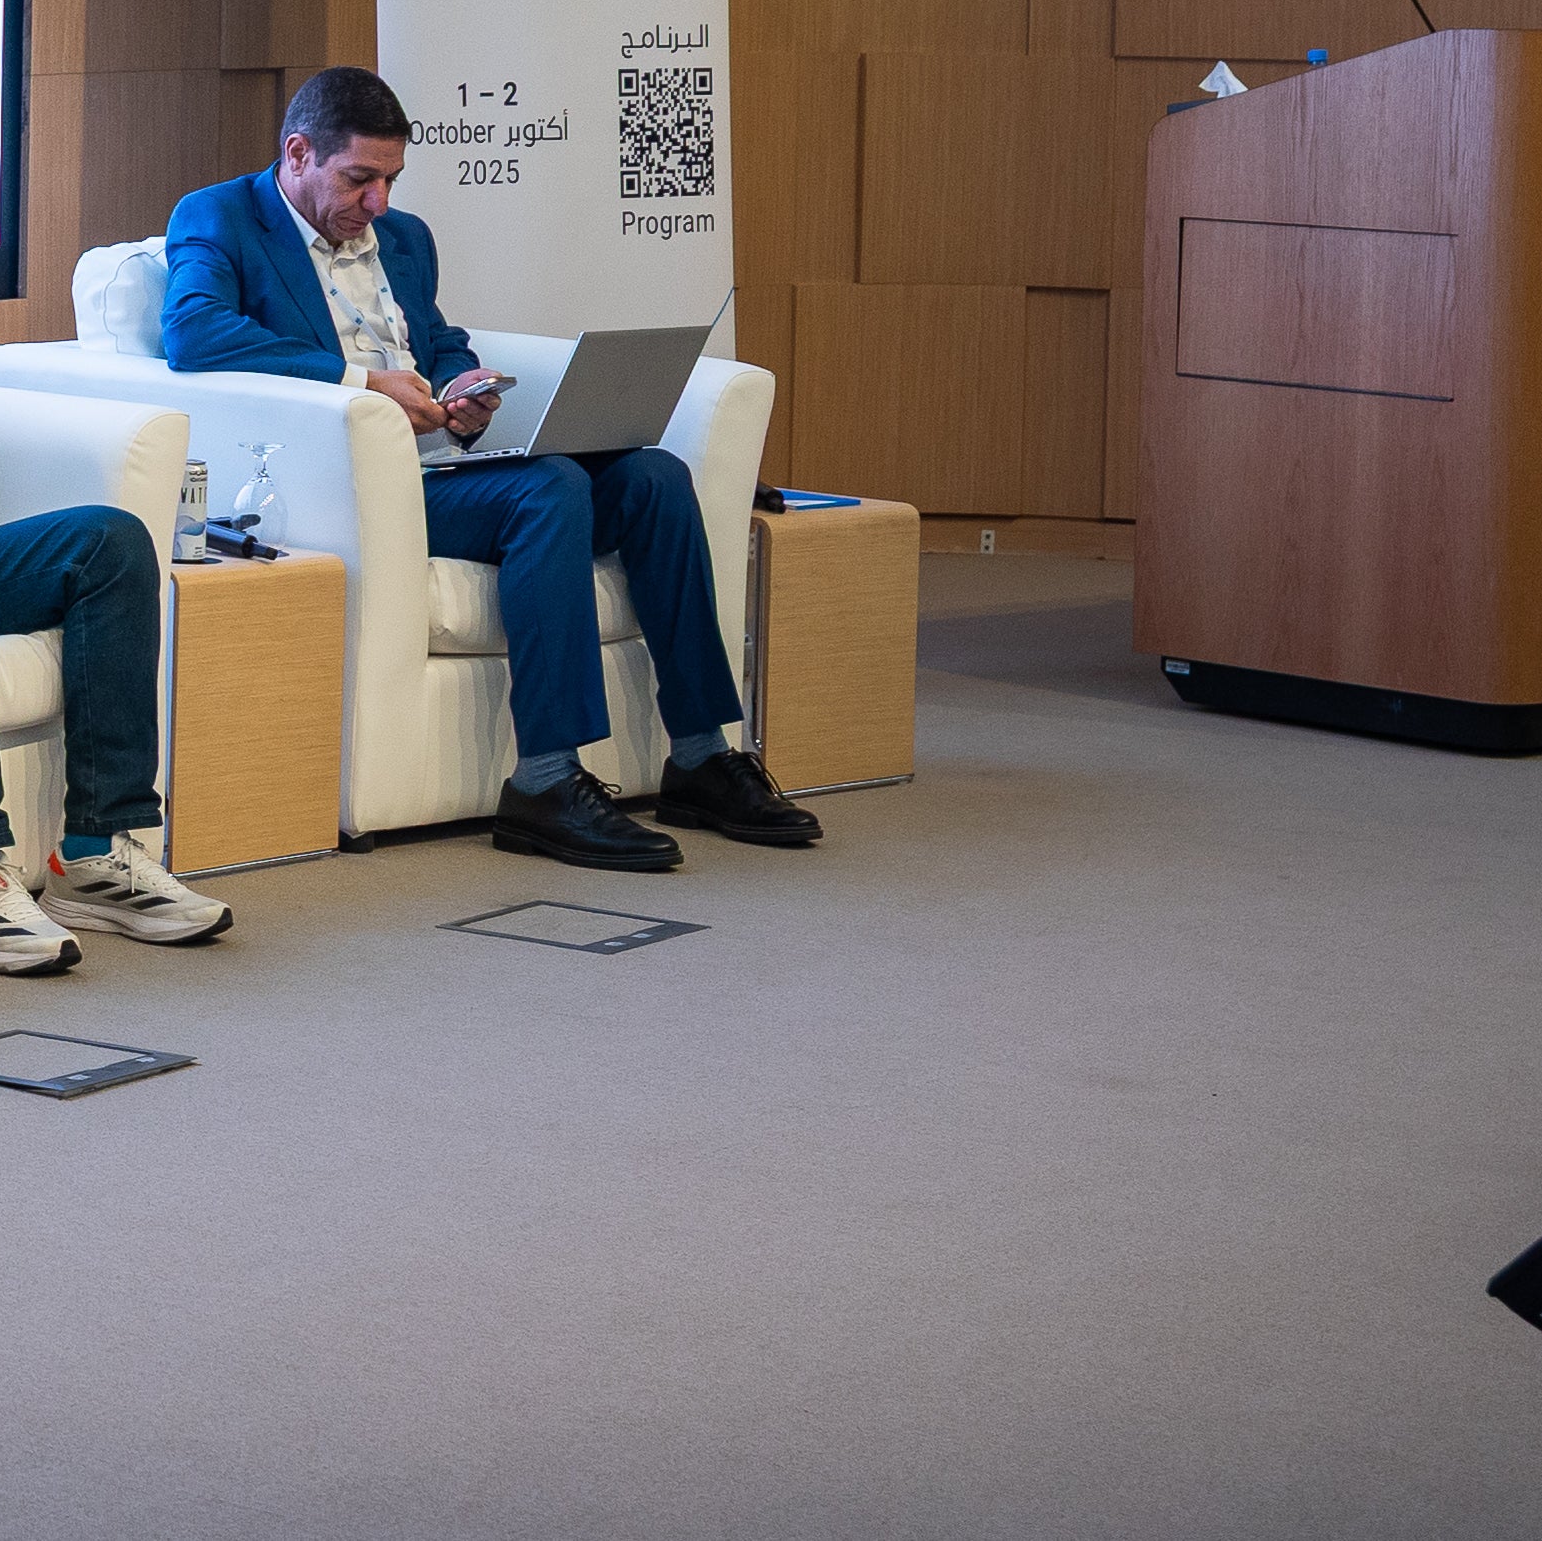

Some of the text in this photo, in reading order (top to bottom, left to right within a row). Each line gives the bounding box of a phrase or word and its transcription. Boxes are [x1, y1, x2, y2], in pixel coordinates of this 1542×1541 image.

[620, 23, 709, 59] البرنامج
[457, 82, 468, 108] 1
[503, 81, 519, 107] 2
[410, 120, 494, 145] October
[503, 108, 568, 148] أكتوبر
[458, 158, 520, 186] 2025
[622, 210, 715, 241] Program
